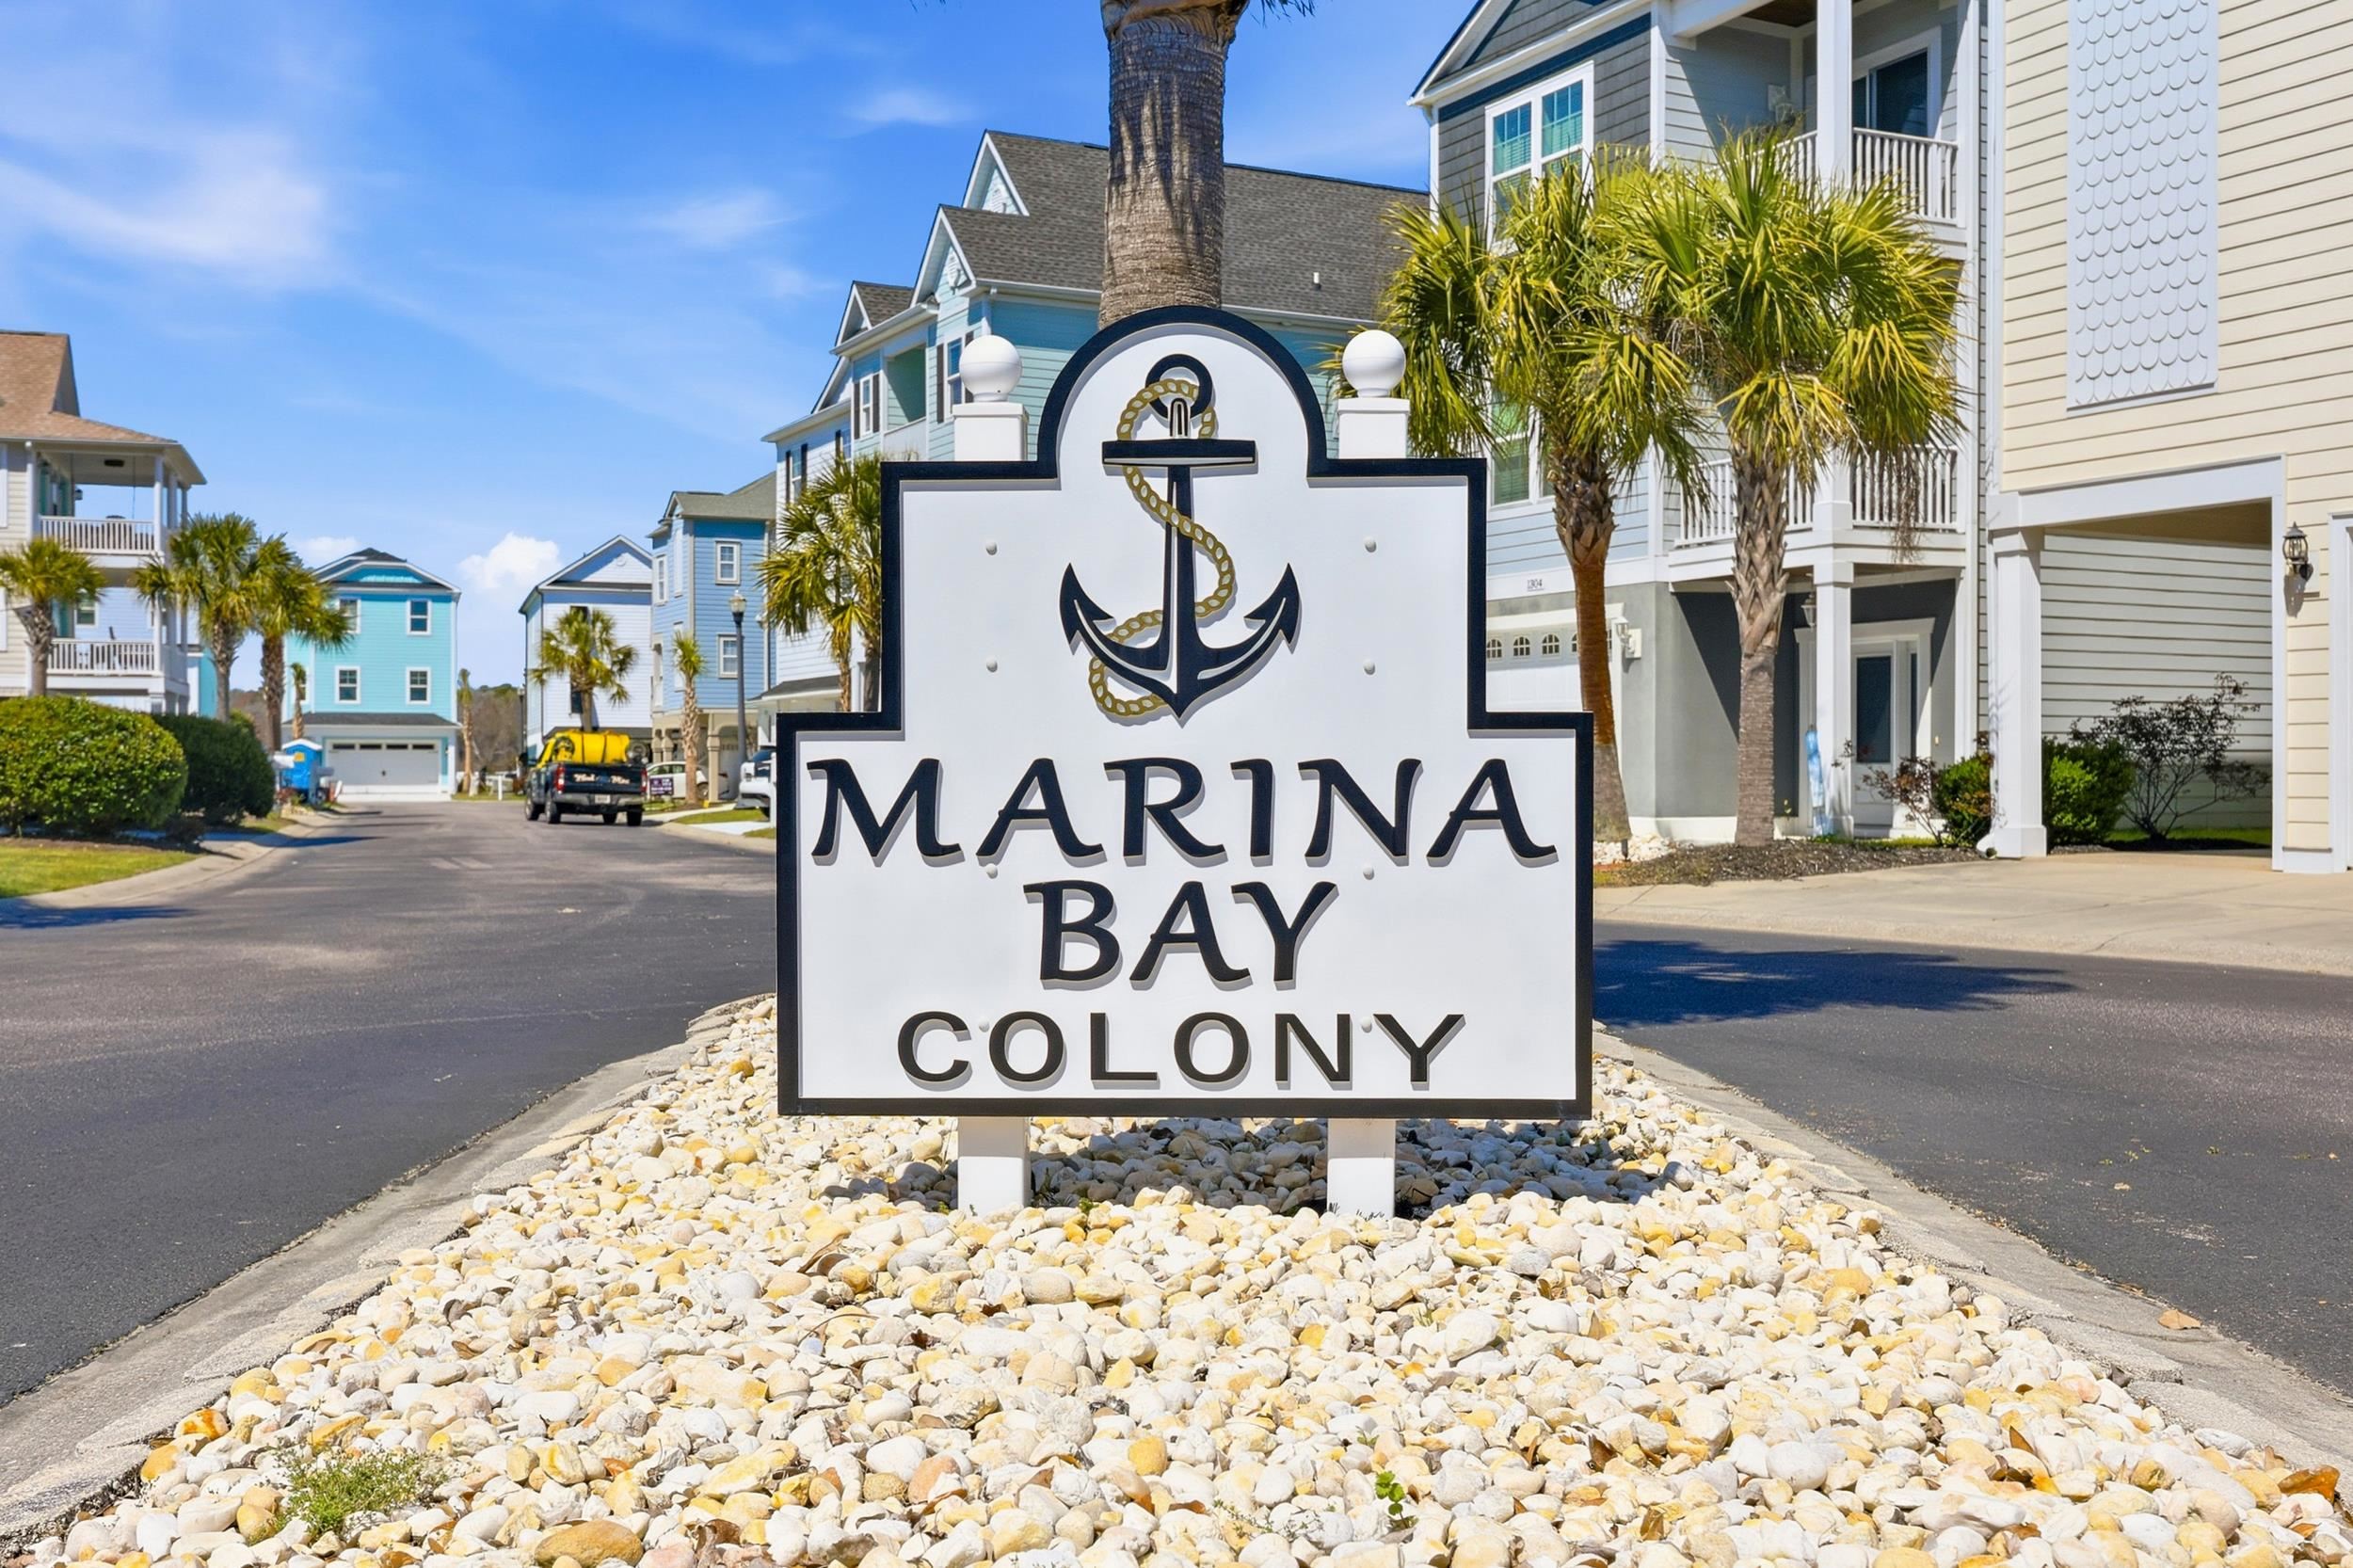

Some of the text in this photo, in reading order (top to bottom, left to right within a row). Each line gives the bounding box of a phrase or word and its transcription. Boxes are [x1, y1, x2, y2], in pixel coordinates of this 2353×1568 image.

[807, 757, 1557, 859] MARINA
[1023, 880, 1337, 983] BAY
[898, 1011, 1464, 1083] COLONY
